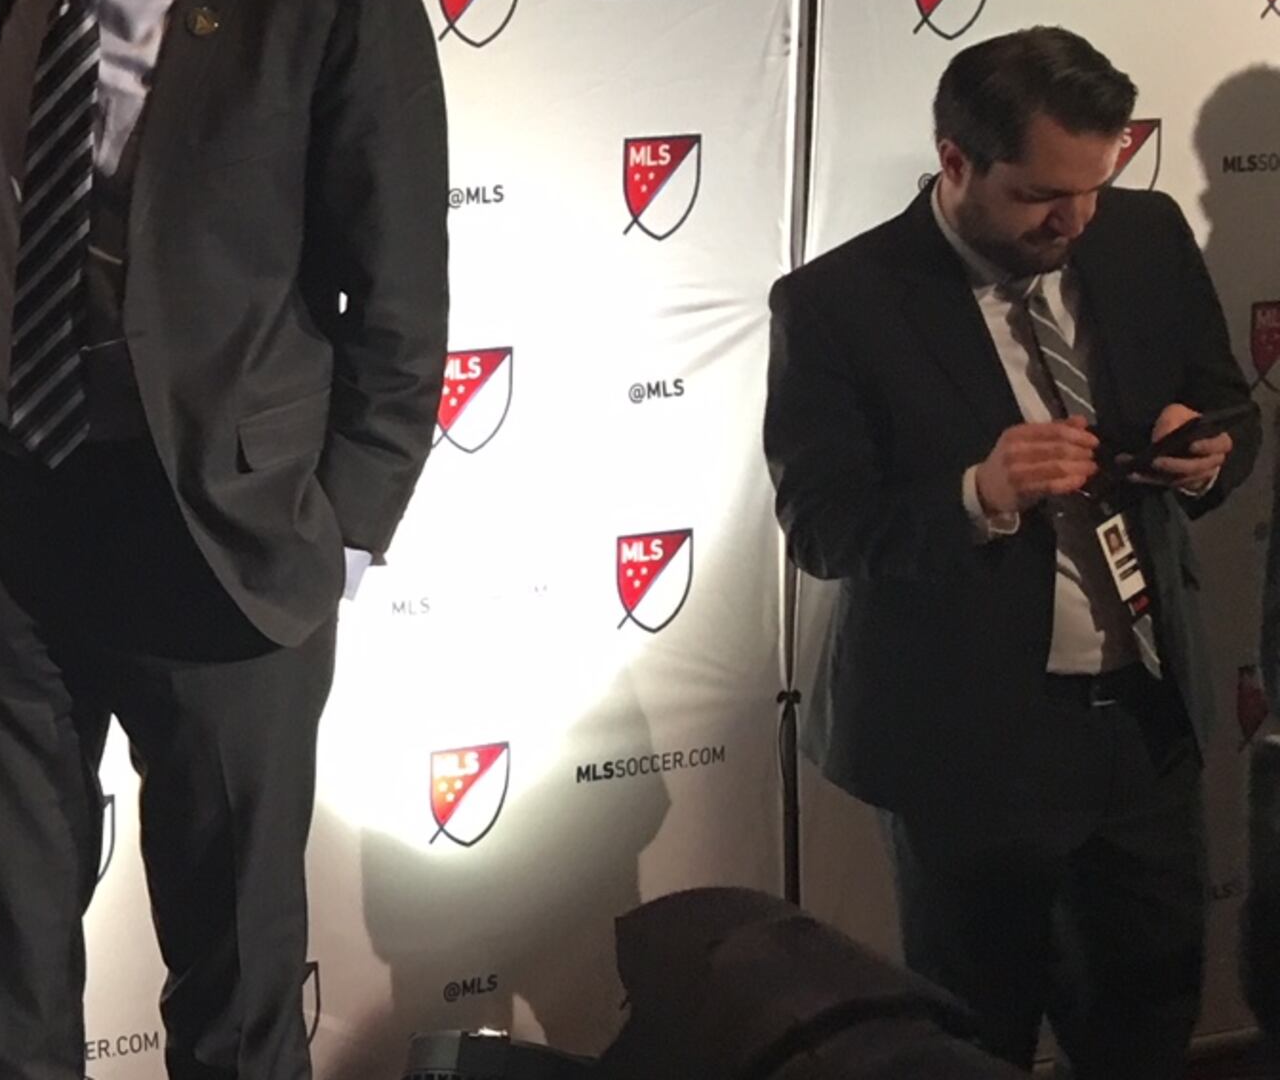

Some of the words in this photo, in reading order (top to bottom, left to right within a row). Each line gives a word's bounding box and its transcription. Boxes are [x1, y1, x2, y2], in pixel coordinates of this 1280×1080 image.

[629, 144, 671, 167] MLS
[448, 185, 503, 209] @MLS
[628, 377, 685, 404] @MLS
[621, 539, 663, 563] MLS
[577, 745, 725, 783] MLSSOCCER.COM
[443, 974, 498, 1003] @MLS
